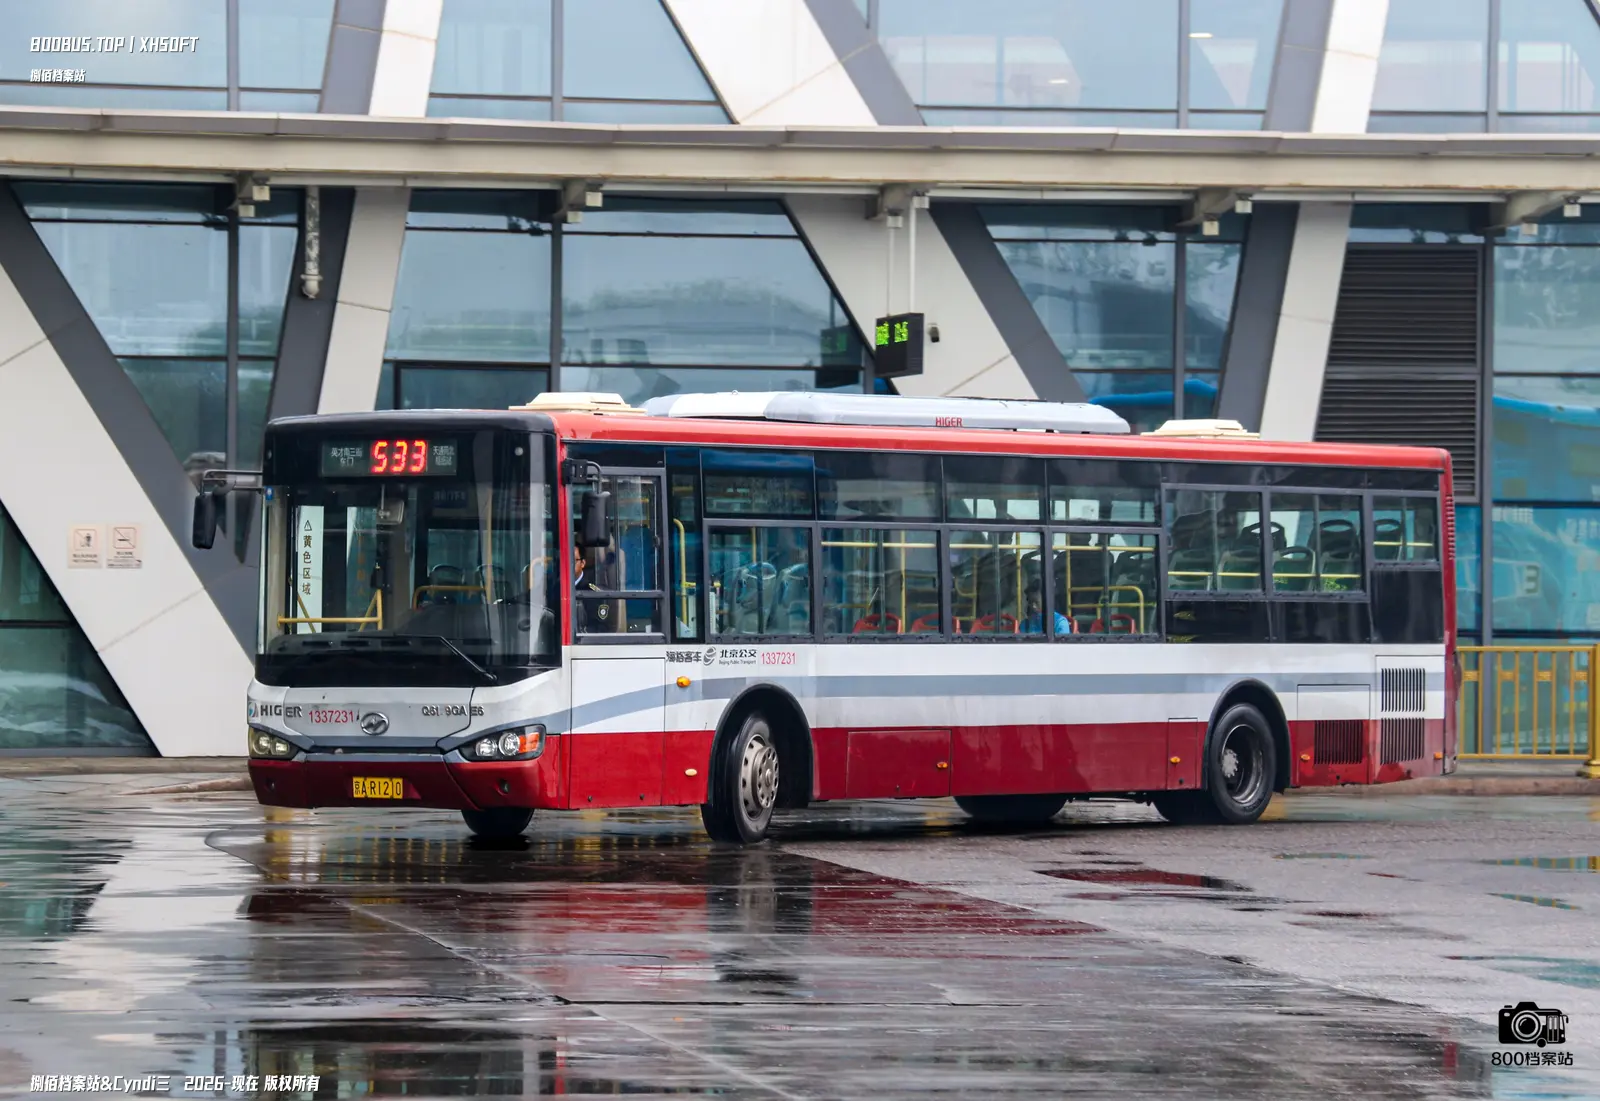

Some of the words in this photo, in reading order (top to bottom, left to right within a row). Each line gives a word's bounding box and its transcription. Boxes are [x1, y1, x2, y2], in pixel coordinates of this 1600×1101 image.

[935, 416, 963, 427] HIGER
[370, 440, 427, 473] 533
[302, 534, 312, 595] 黄色区域
[719, 648, 757, 658] 北京公交
[761, 651, 796, 665] 1337231
[260, 704, 302, 718] HIGER
[308, 709, 354, 724] 1337231
